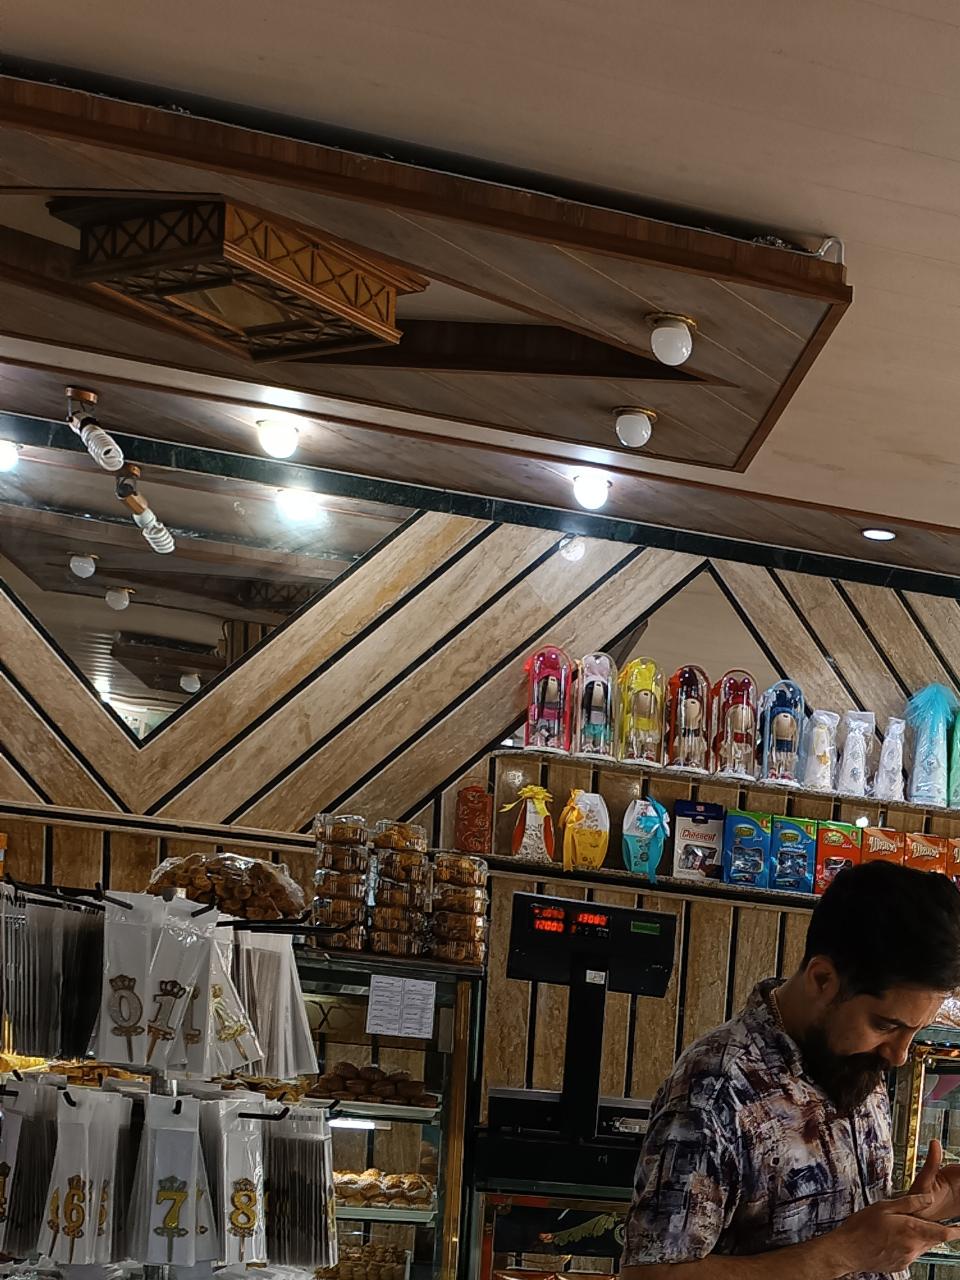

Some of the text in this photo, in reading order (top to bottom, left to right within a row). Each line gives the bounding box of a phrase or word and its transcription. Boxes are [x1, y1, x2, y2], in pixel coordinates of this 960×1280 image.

[63, 1188, 85, 1229] 6
[156, 1191, 188, 1230] 7
[231, 1190, 257, 1230] 8
